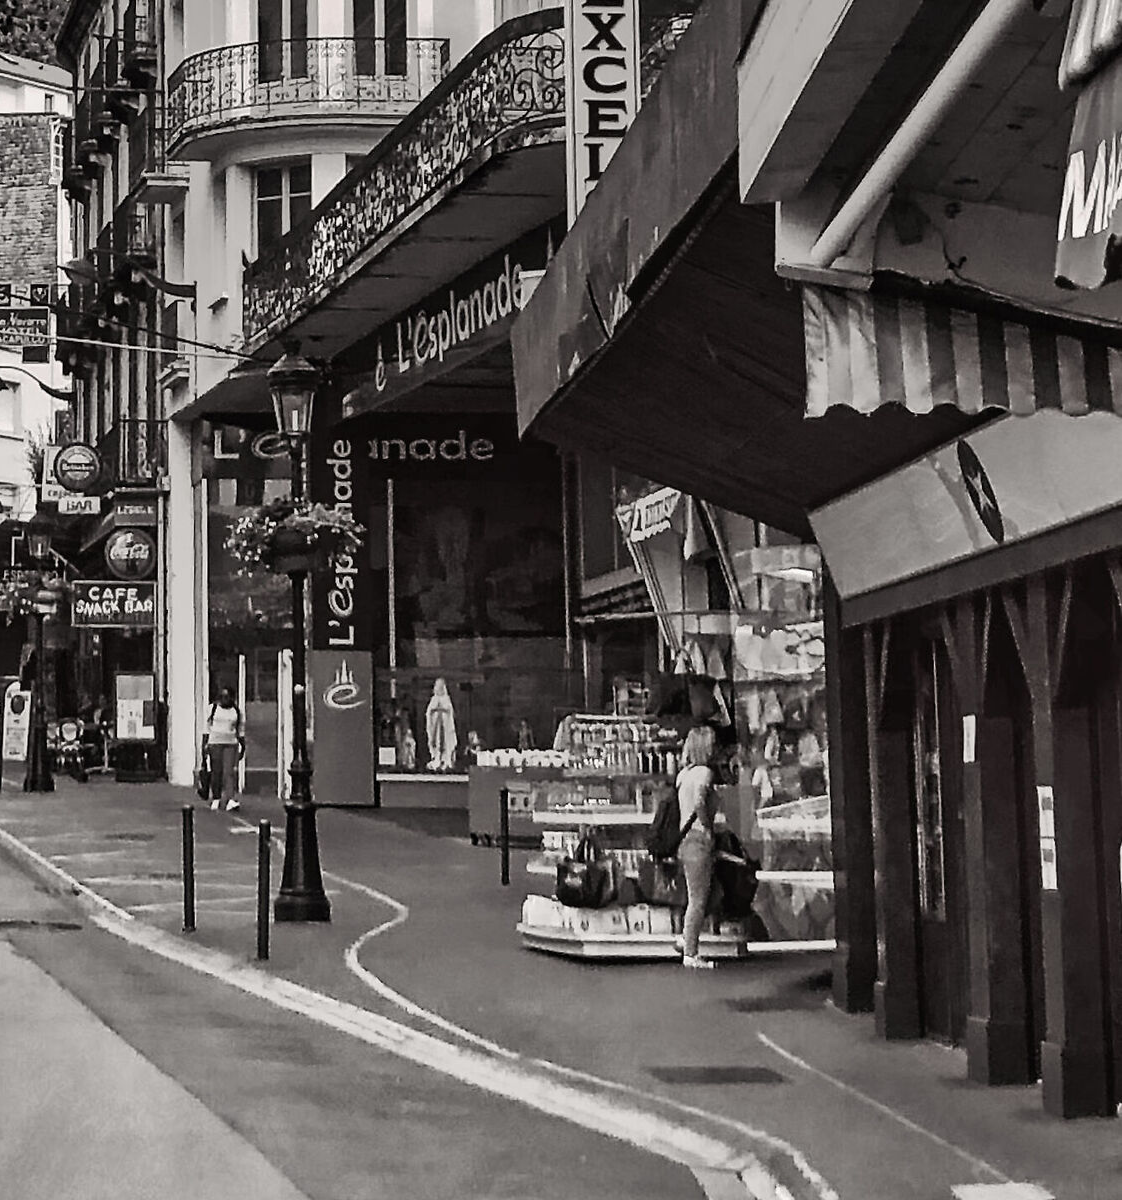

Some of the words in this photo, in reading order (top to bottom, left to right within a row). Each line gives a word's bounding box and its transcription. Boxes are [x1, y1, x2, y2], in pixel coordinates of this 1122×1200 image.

[88, 586, 138, 601] CAFE
[76, 599, 120, 617] SNACK
[124, 599, 153, 613] BAR
